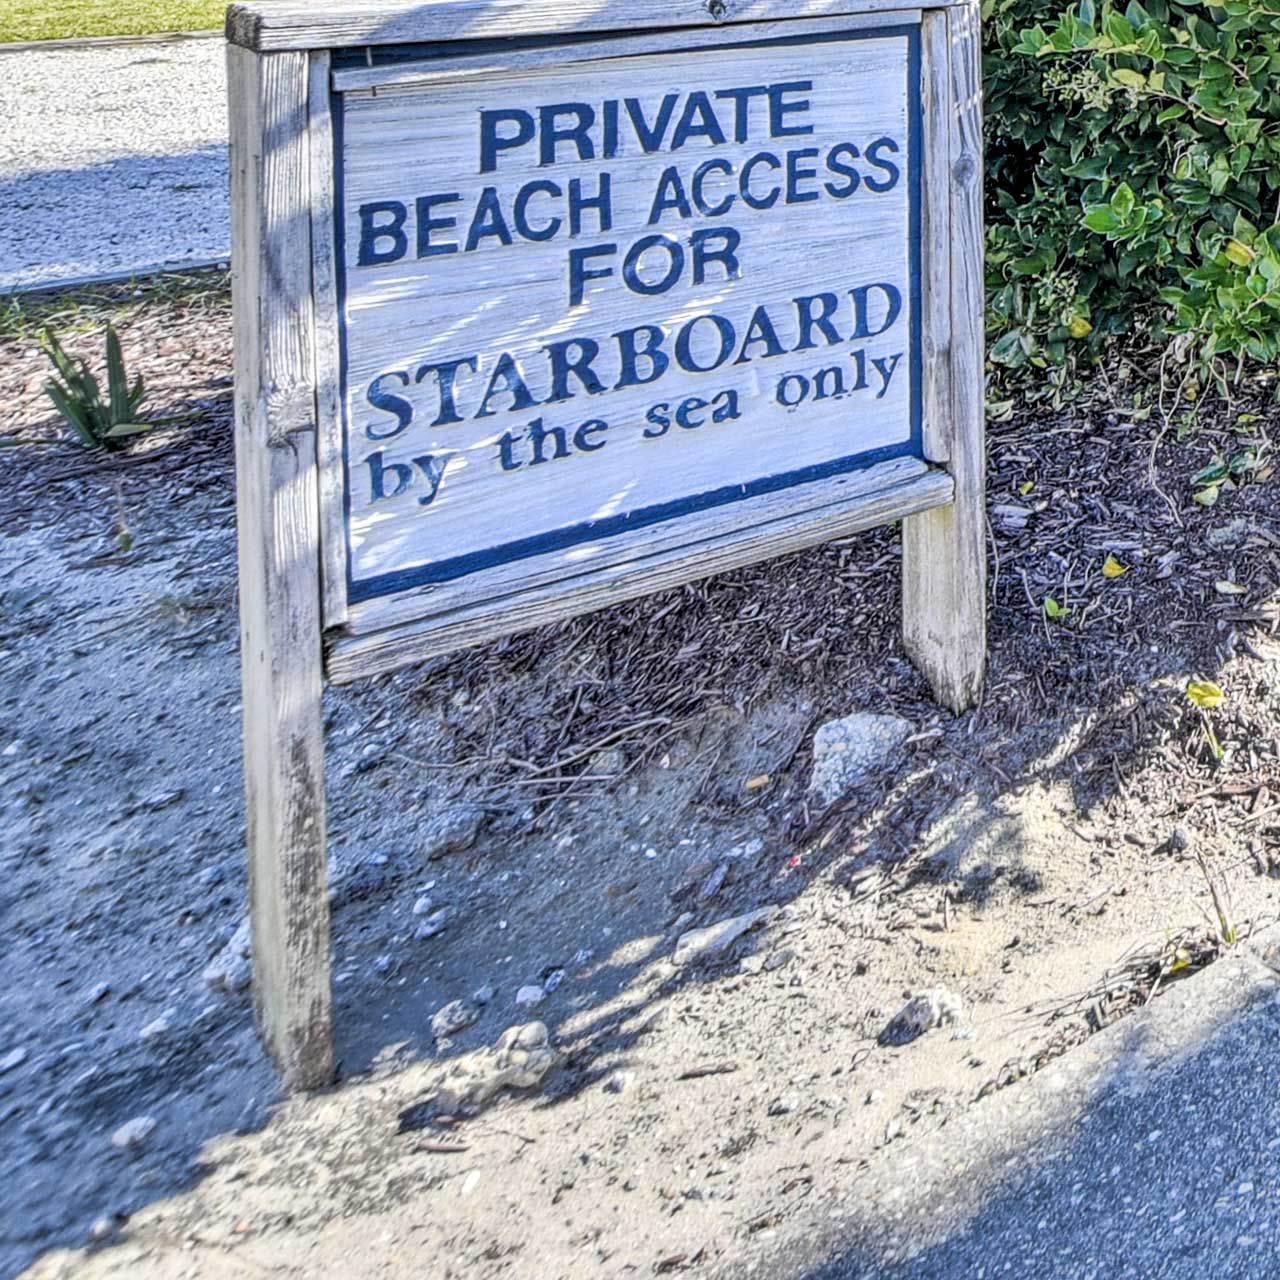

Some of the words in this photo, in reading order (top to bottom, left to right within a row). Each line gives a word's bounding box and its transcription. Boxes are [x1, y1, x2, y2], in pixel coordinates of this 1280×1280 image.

[479, 81, 813, 173] PRIVATE
[357, 173, 612, 267] BEACH
[648, 137, 900, 224] ACCESS
[568, 227, 741, 307] FOR
[365, 282, 902, 441] STARBOARD
[364, 450, 448, 505] by
[499, 412, 609, 472] the
[642, 388, 741, 440] sea
[776, 349, 902, 408] only
